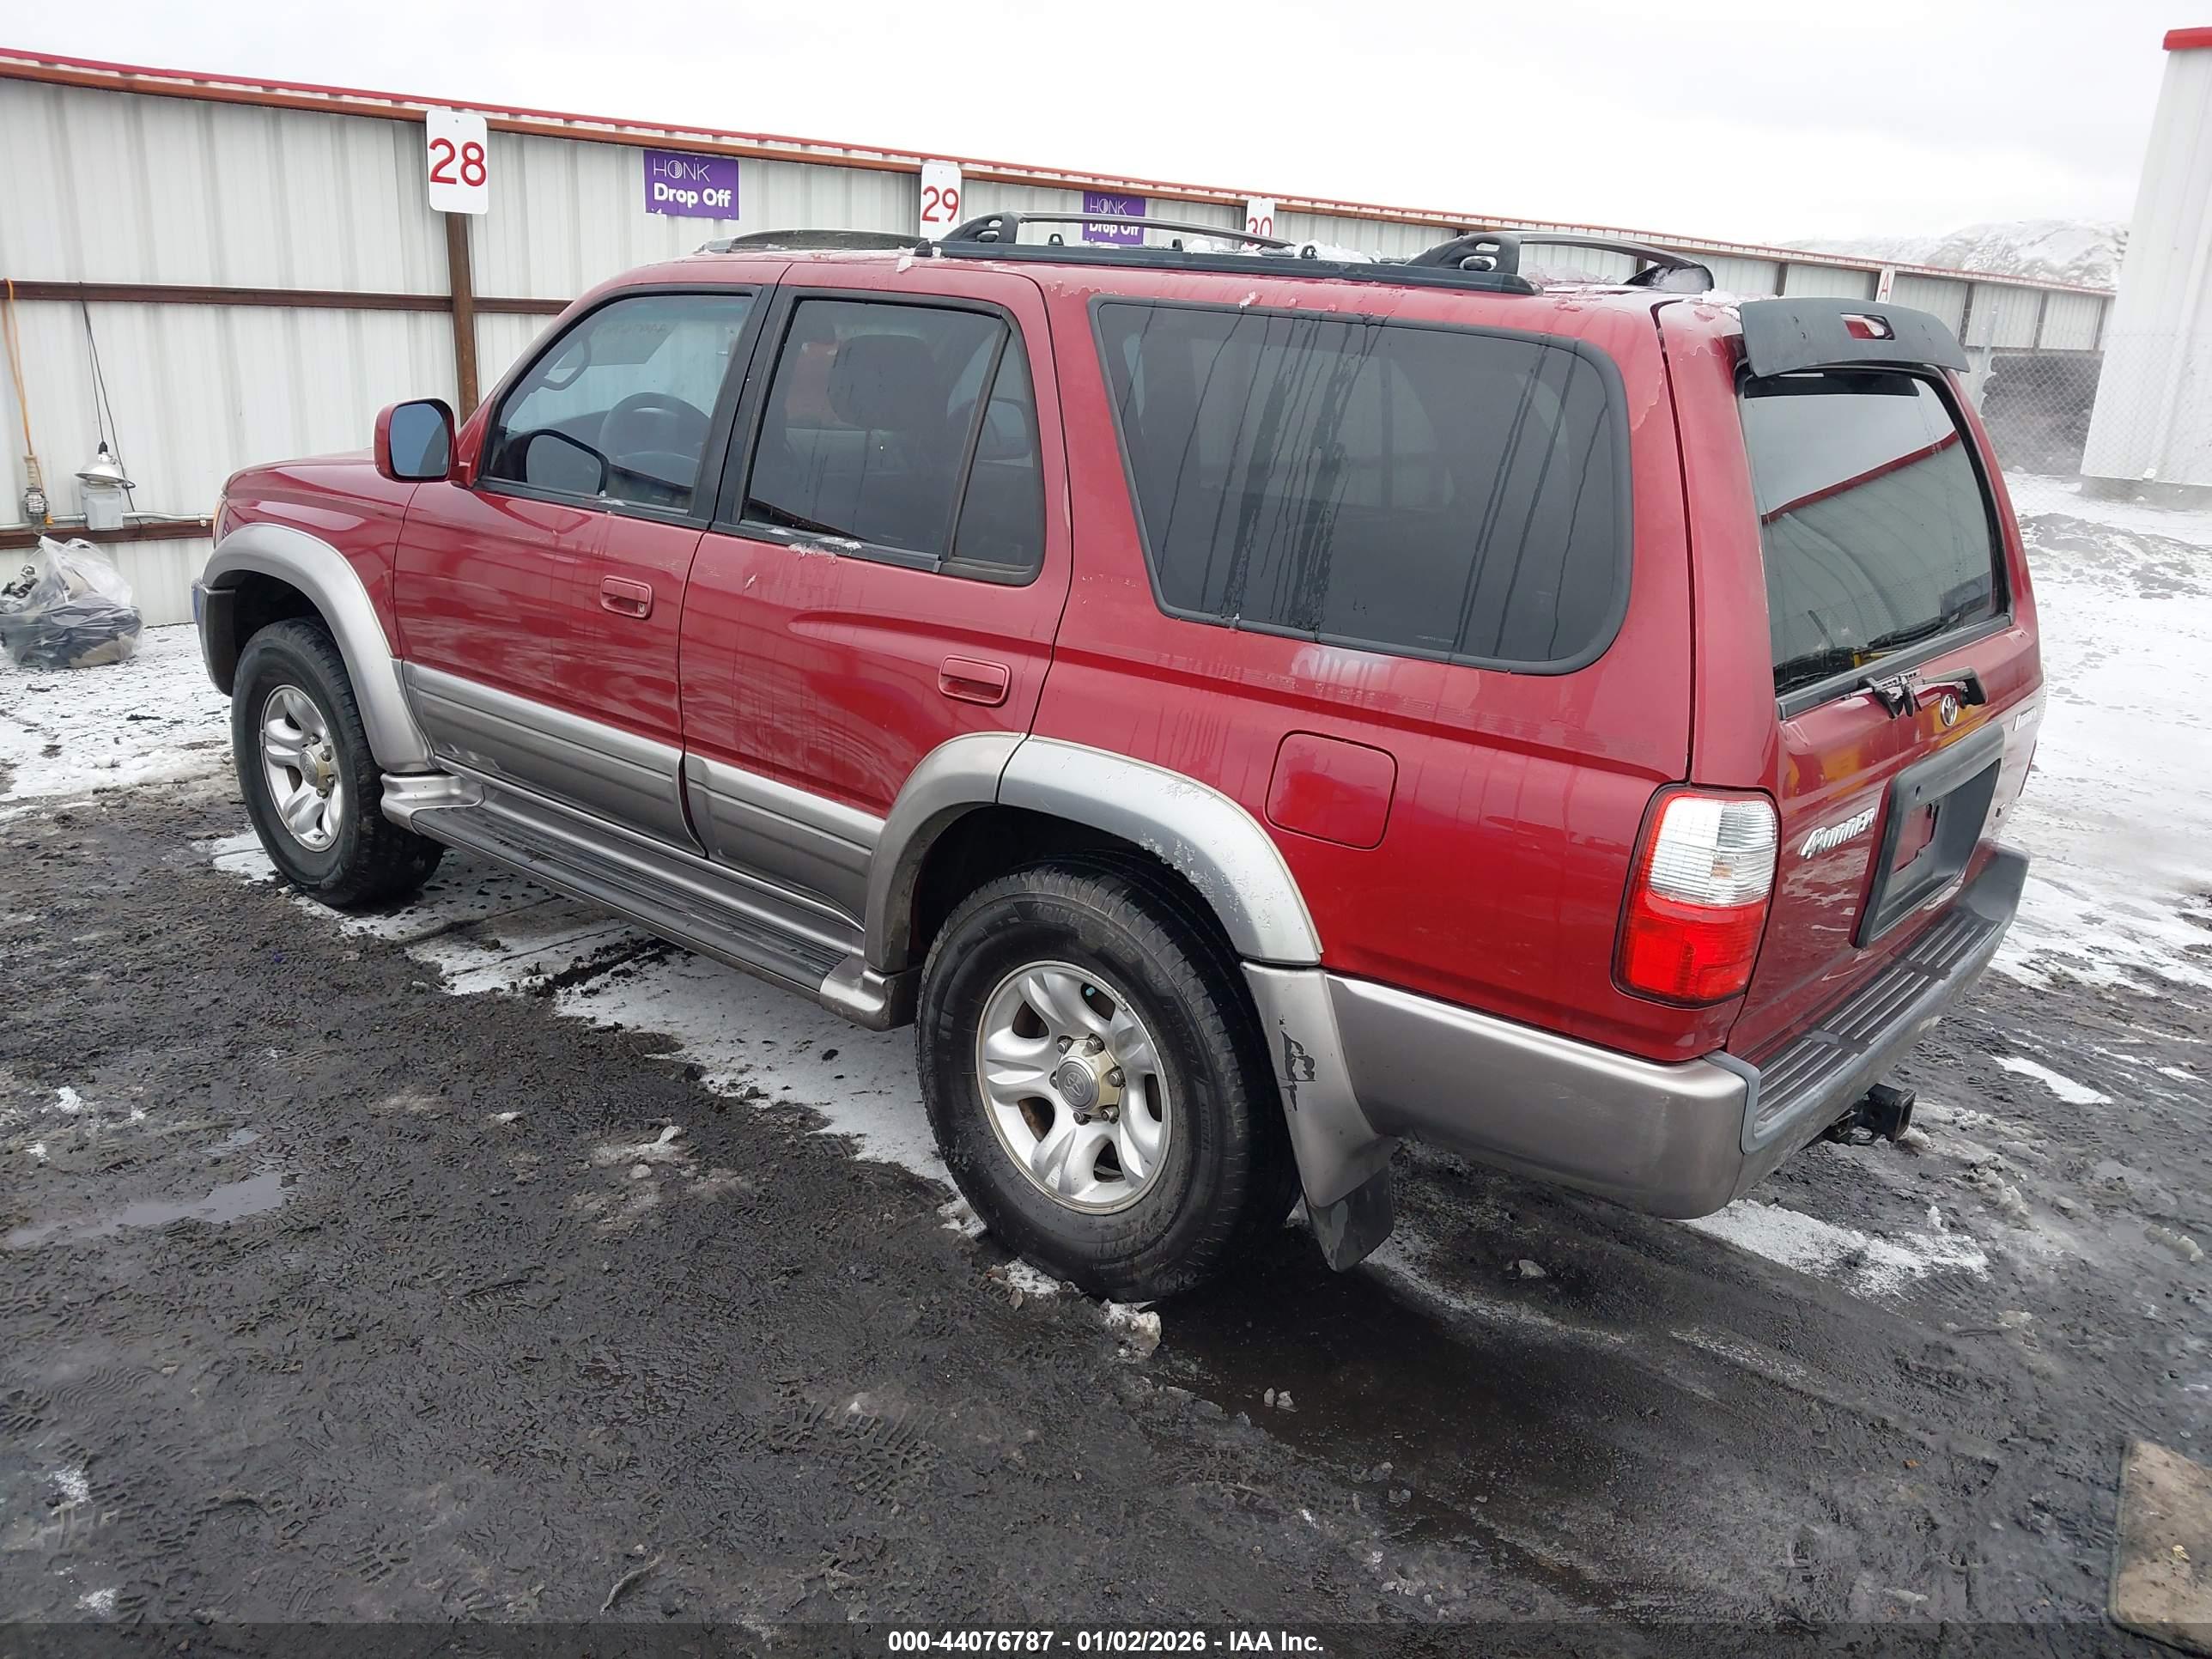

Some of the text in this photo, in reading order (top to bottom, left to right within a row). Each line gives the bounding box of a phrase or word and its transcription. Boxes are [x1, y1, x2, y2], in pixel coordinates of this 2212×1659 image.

[429, 138, 486, 186] 28
[653, 157, 710, 182] HONK
[653, 182, 732, 209] Drop Off
[922, 185, 959, 222] 29
[1090, 197, 1127, 216] HONK
